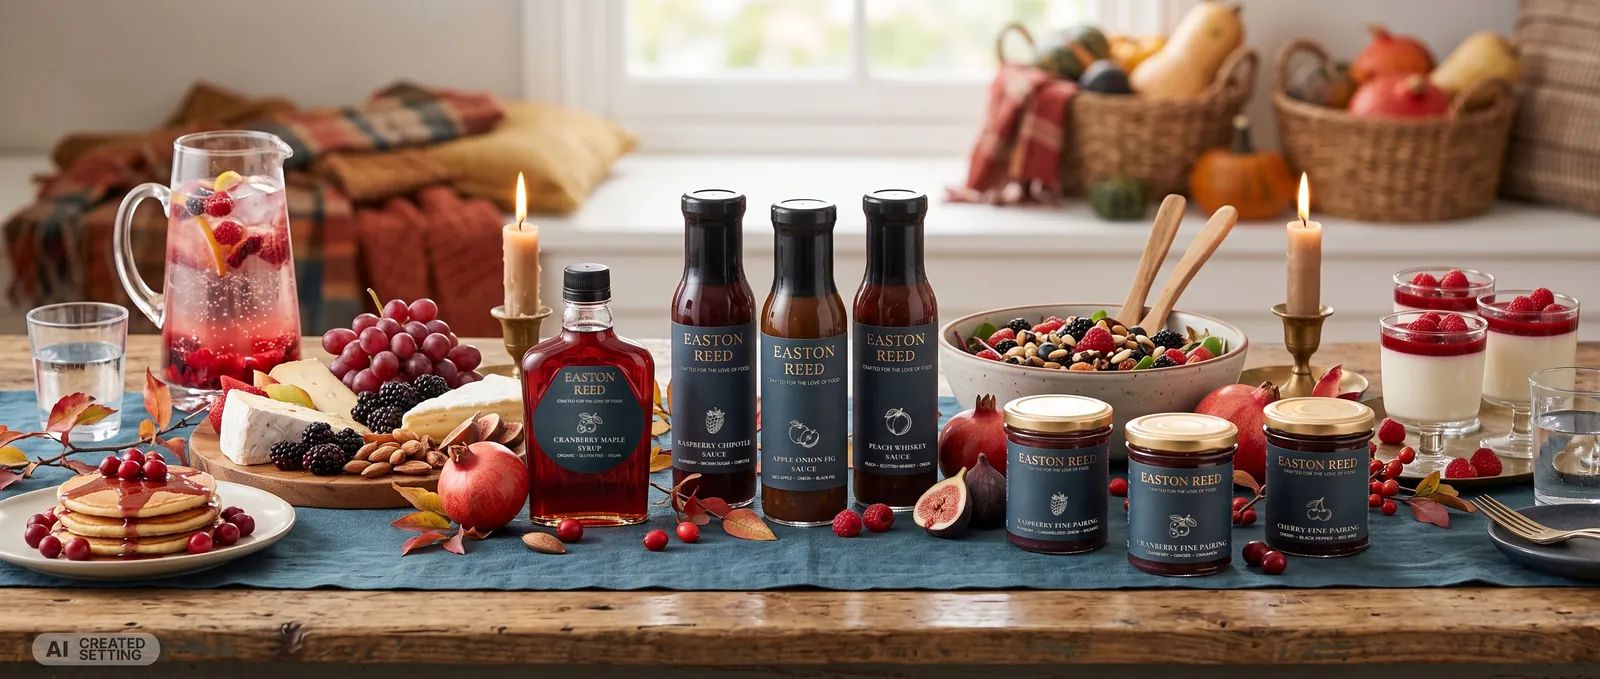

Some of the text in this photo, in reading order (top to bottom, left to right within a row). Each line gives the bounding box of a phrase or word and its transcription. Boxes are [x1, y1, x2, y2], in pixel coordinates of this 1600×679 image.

[684, 333, 743, 346] EASTON
[867, 333, 926, 346] EASTON
[694, 350, 733, 362] REED
[773, 345, 835, 360] EASTON
[877, 350, 915, 362] REED
[784, 363, 824, 375] REED
[565, 372, 615, 382] EASTON
[574, 386, 606, 395] REED
[677, 439, 751, 448] RASPBERRY CHIPOTLE
[1019, 453, 1097, 466] EASTON REED
[1278, 456, 1324, 470] EASTON
[1329, 458, 1357, 470] REED
[1141, 472, 1222, 486] EASTON REED
[1017, 518, 1054, 528] RASPBERRY
[1073, 518, 1098, 528] PAIRING
[1277, 523, 1306, 533] CHERRY
[1329, 524, 1360, 533] PAIRING
[1137, 540, 1178, 551] CRANBERRY
[1200, 540, 1227, 550] PAIRING
